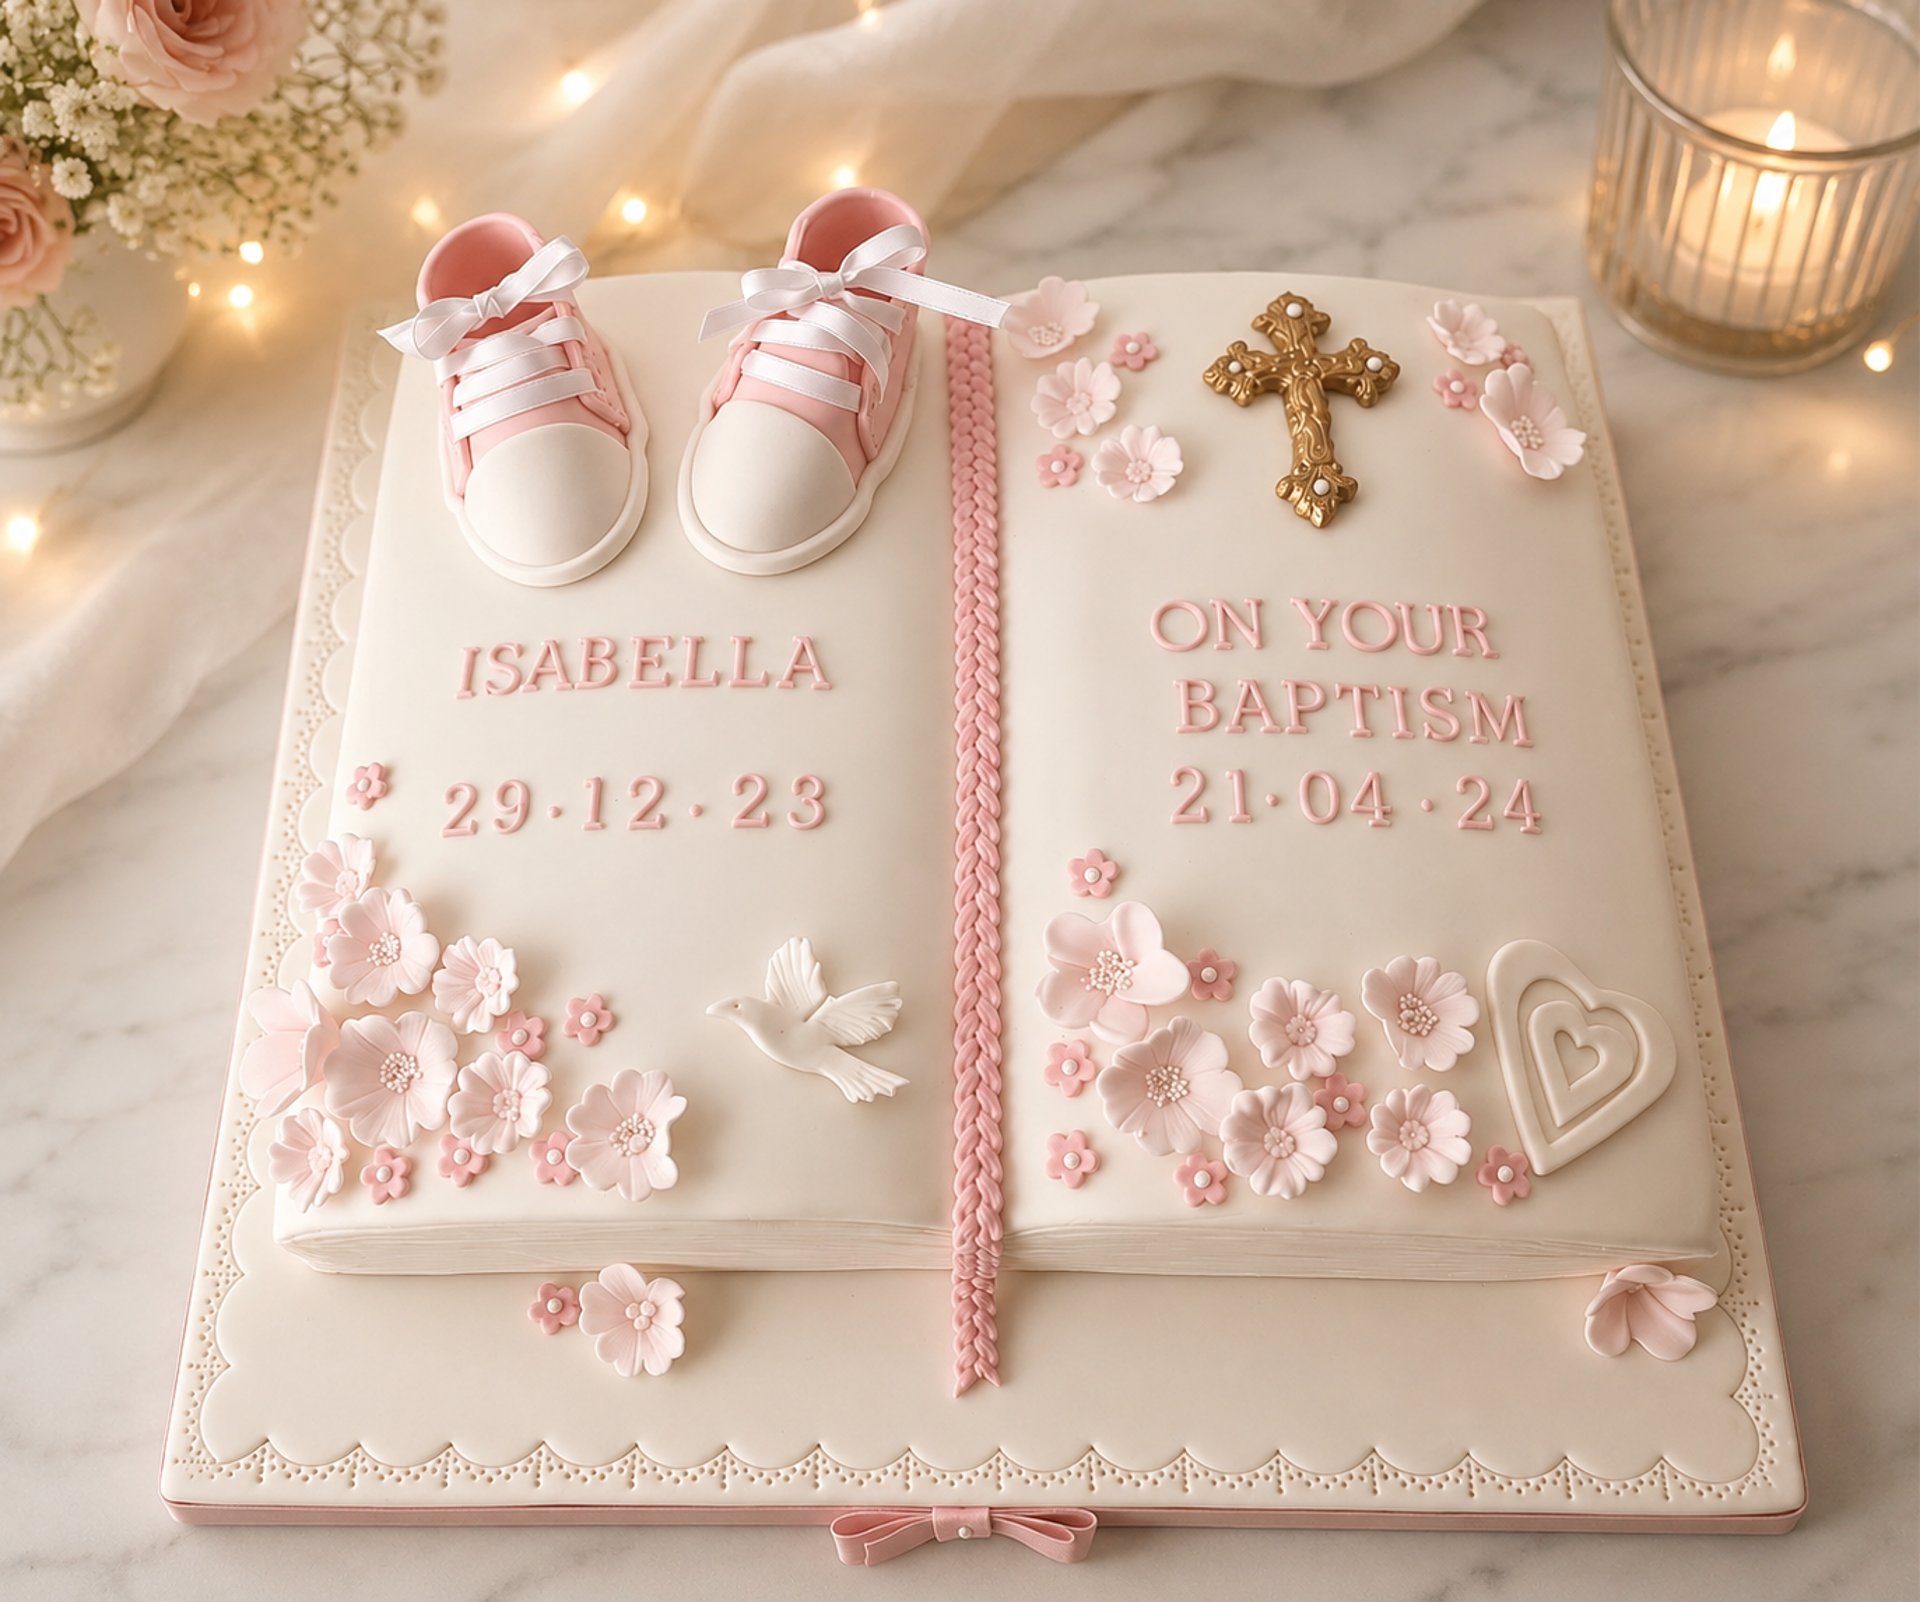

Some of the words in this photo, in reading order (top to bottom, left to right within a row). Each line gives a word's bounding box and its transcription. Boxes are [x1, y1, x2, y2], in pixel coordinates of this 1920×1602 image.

[1150, 598, 1264, 652] ON
[1289, 597, 1500, 660] YOUR
[455, 635, 833, 700] ISABELLA
[1172, 678, 1535, 749] BAPTISM
